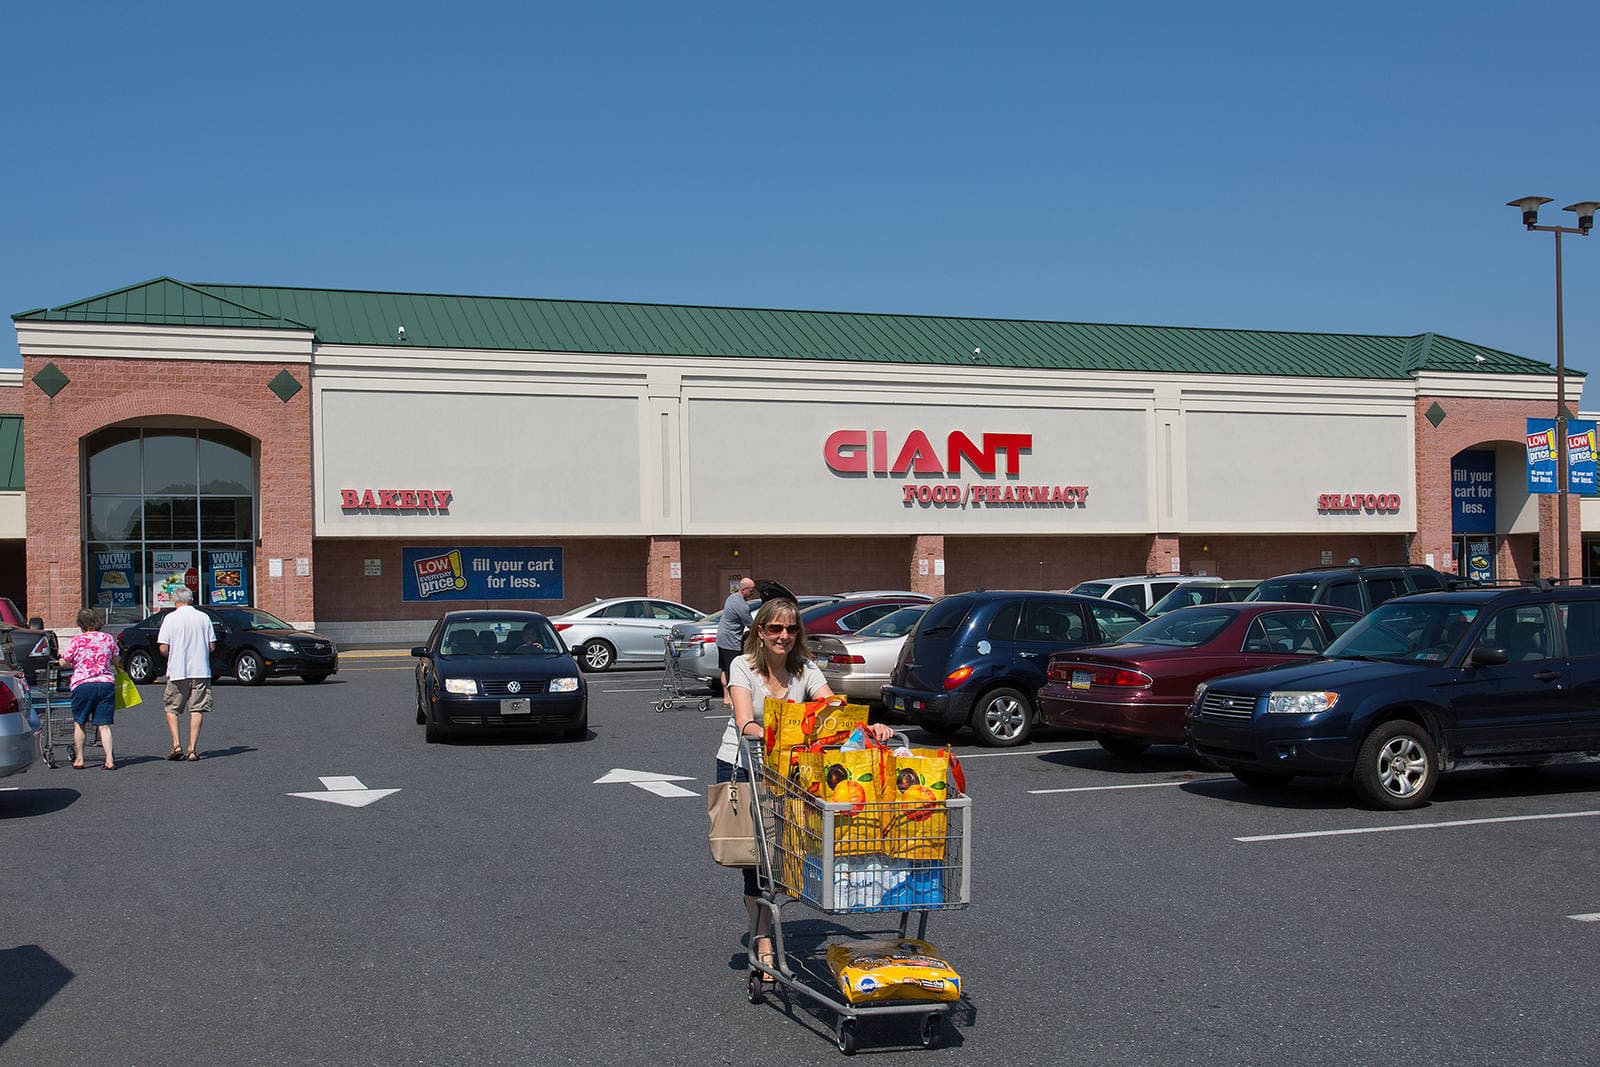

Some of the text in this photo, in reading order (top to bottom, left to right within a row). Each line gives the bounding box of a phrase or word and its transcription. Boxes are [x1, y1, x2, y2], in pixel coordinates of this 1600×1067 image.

[1528, 435, 1547, 446] LOW
[1569, 436, 1588, 447] LOW
[824, 429, 1032, 474] GIANT
[1453, 469, 1492, 484] fill your
[902, 484, 1088, 504] FOOD/PHARMACY
[1454, 486, 1492, 498] cart for
[340, 489, 452, 510] BAKERY
[1318, 493, 1401, 511] SEAFOOD
[1462, 501, 1486, 513] less.
[98, 553, 131, 565] WOW!
[211, 552, 243, 564] WOW!
[154, 561, 189, 570] savory
[418, 558, 448, 575] LOW
[472, 558, 554, 574] fill your cart
[186, 576, 198, 584] STOP
[420, 571, 452, 582] EVERYDAY
[487, 575, 540, 588] for less.
